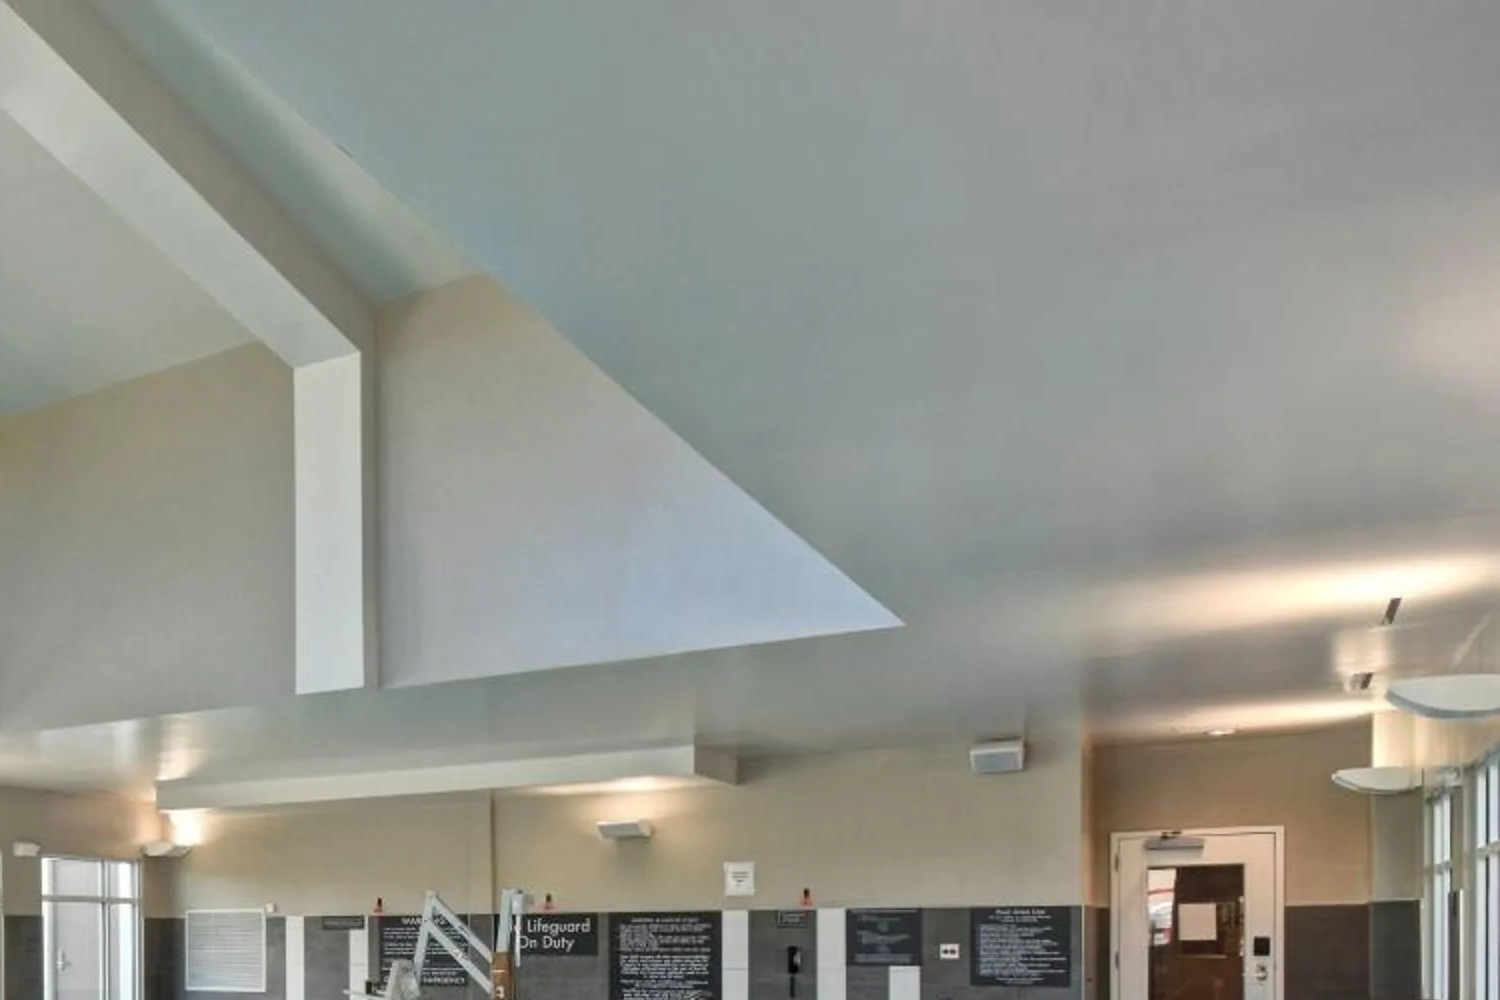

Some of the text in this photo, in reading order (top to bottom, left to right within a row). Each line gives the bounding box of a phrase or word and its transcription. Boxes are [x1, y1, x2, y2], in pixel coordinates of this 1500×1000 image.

[527, 919, 591, 936] Lifeguard
[519, 936, 575, 952] On Duty
